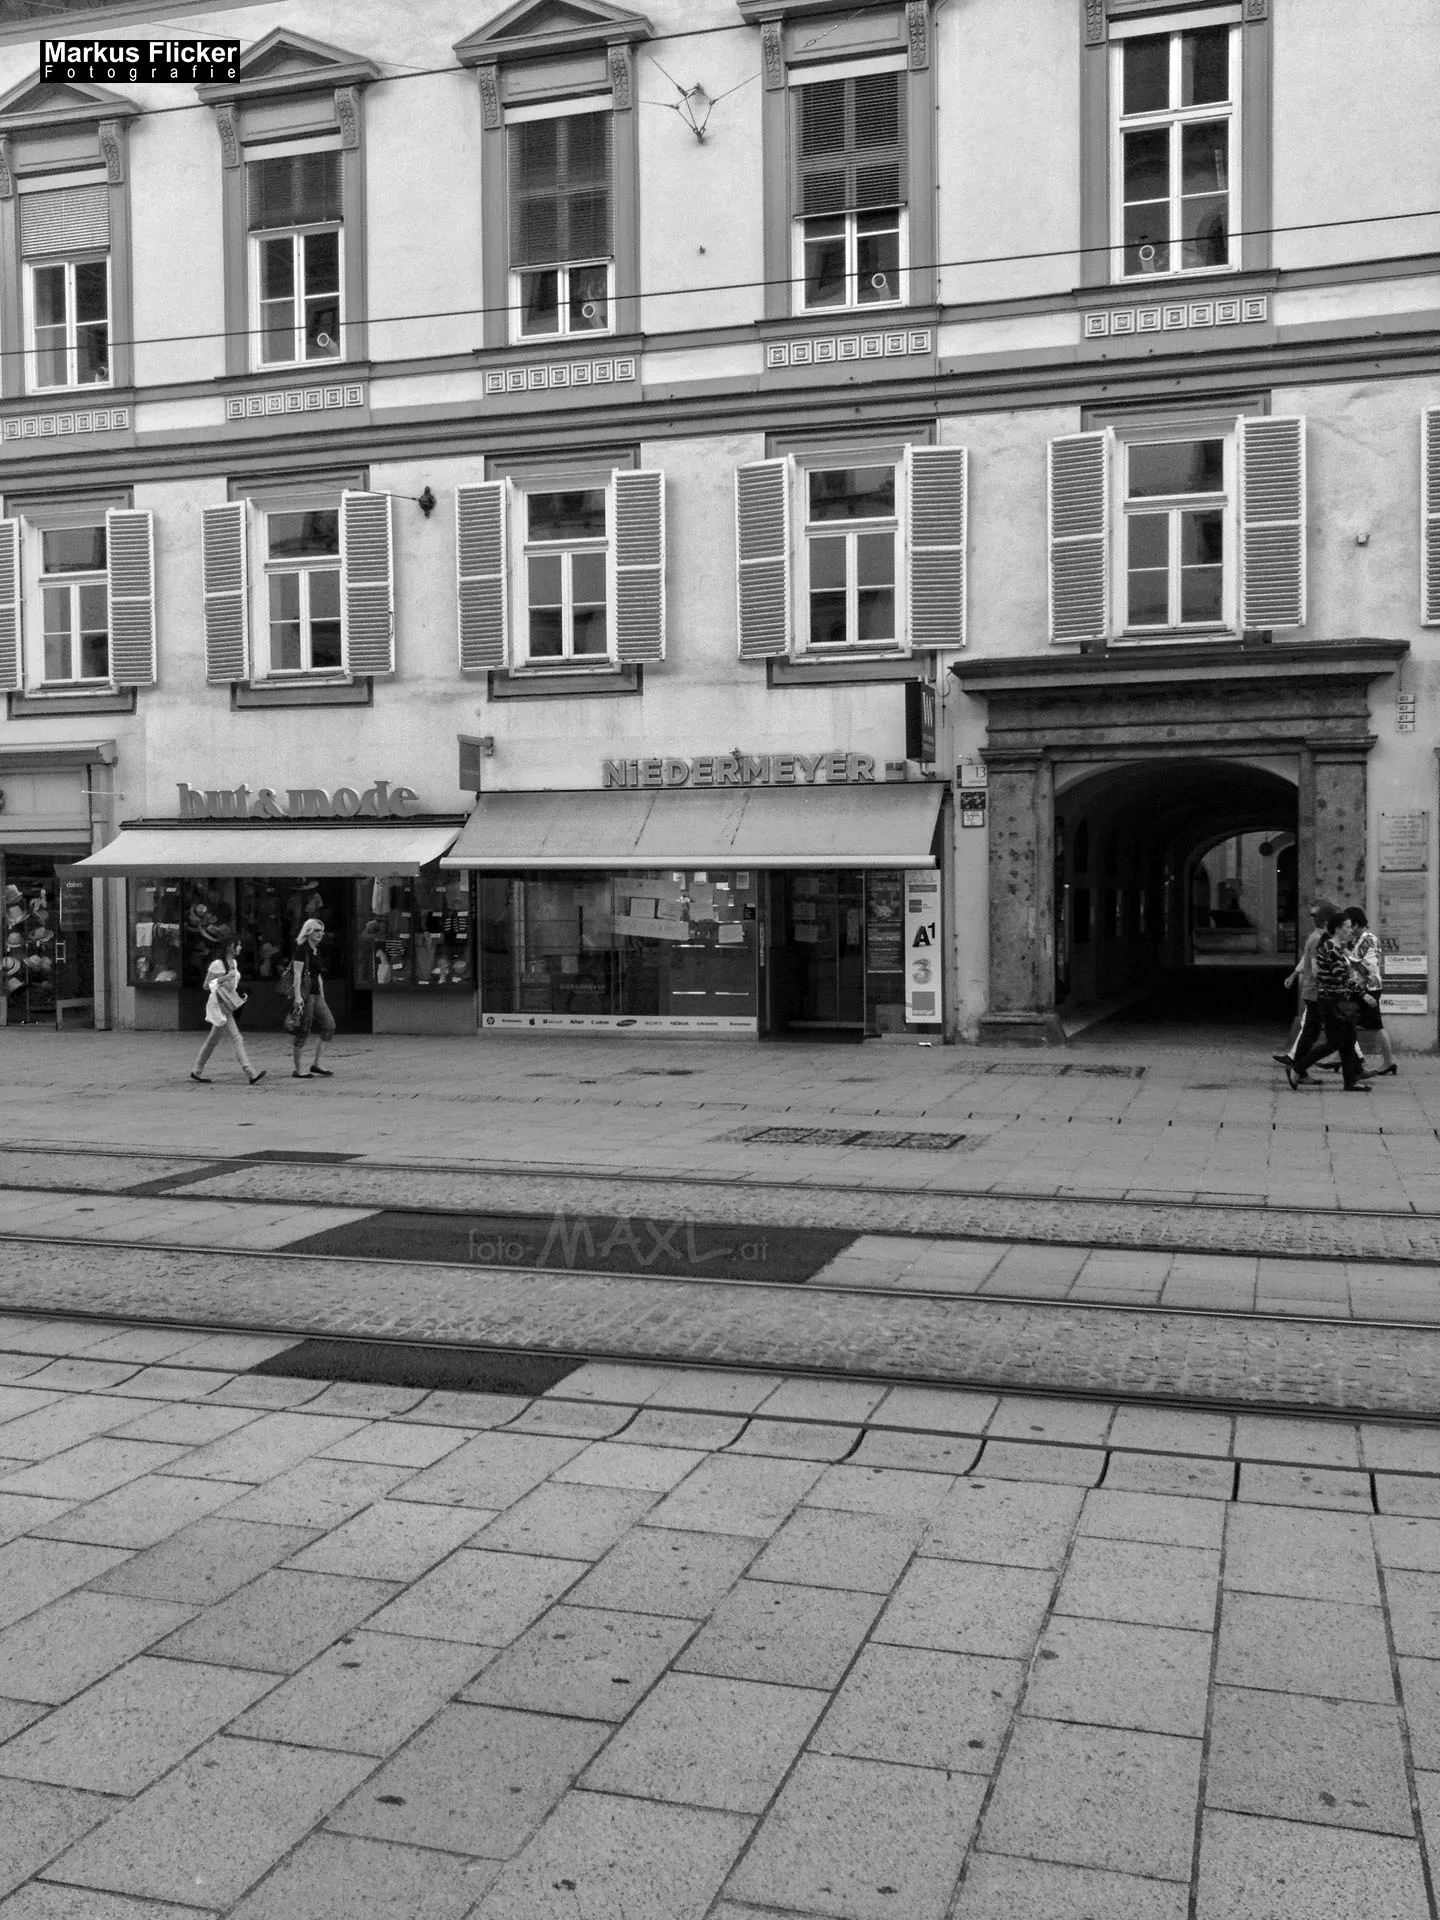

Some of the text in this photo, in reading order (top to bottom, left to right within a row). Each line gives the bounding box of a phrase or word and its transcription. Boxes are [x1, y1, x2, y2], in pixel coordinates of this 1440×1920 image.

[975, 766, 986, 778] 13
[912, 922, 936, 948] A1
[911, 958, 933, 985] 3
